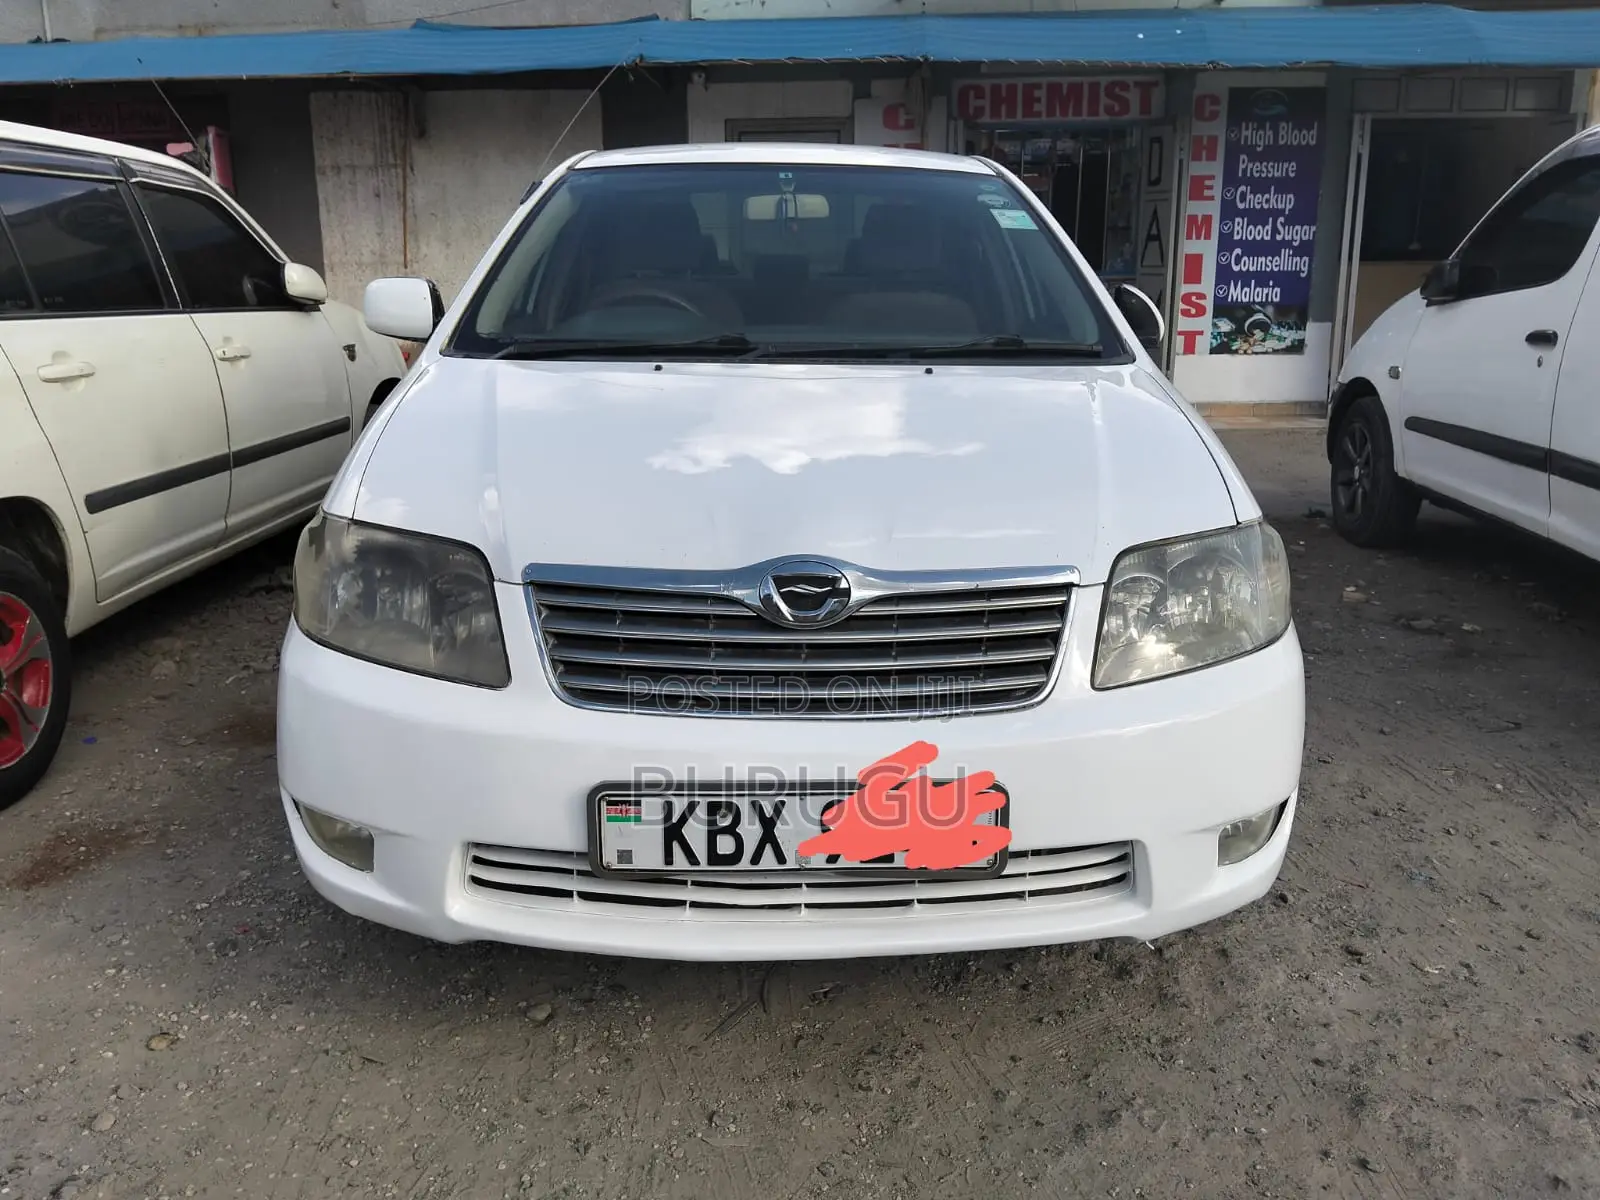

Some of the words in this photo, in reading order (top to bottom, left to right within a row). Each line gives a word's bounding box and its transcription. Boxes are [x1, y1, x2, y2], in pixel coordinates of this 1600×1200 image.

[957, 80, 1159, 120] CHEMIST
[1241, 121, 1273, 151] High
[1279, 121, 1318, 145] Blood
[1239, 154, 1297, 177] Pressure
[1236, 185, 1294, 214] Checkup
[1177, 93, 1221, 355] CHEMIST
[1233, 217, 1272, 240] Blood
[1276, 217, 1316, 246] Sugar
[1231, 248, 1309, 277] Counselling
[1228, 279, 1281, 302] Malaria
[663, 800, 787, 866] KBX
